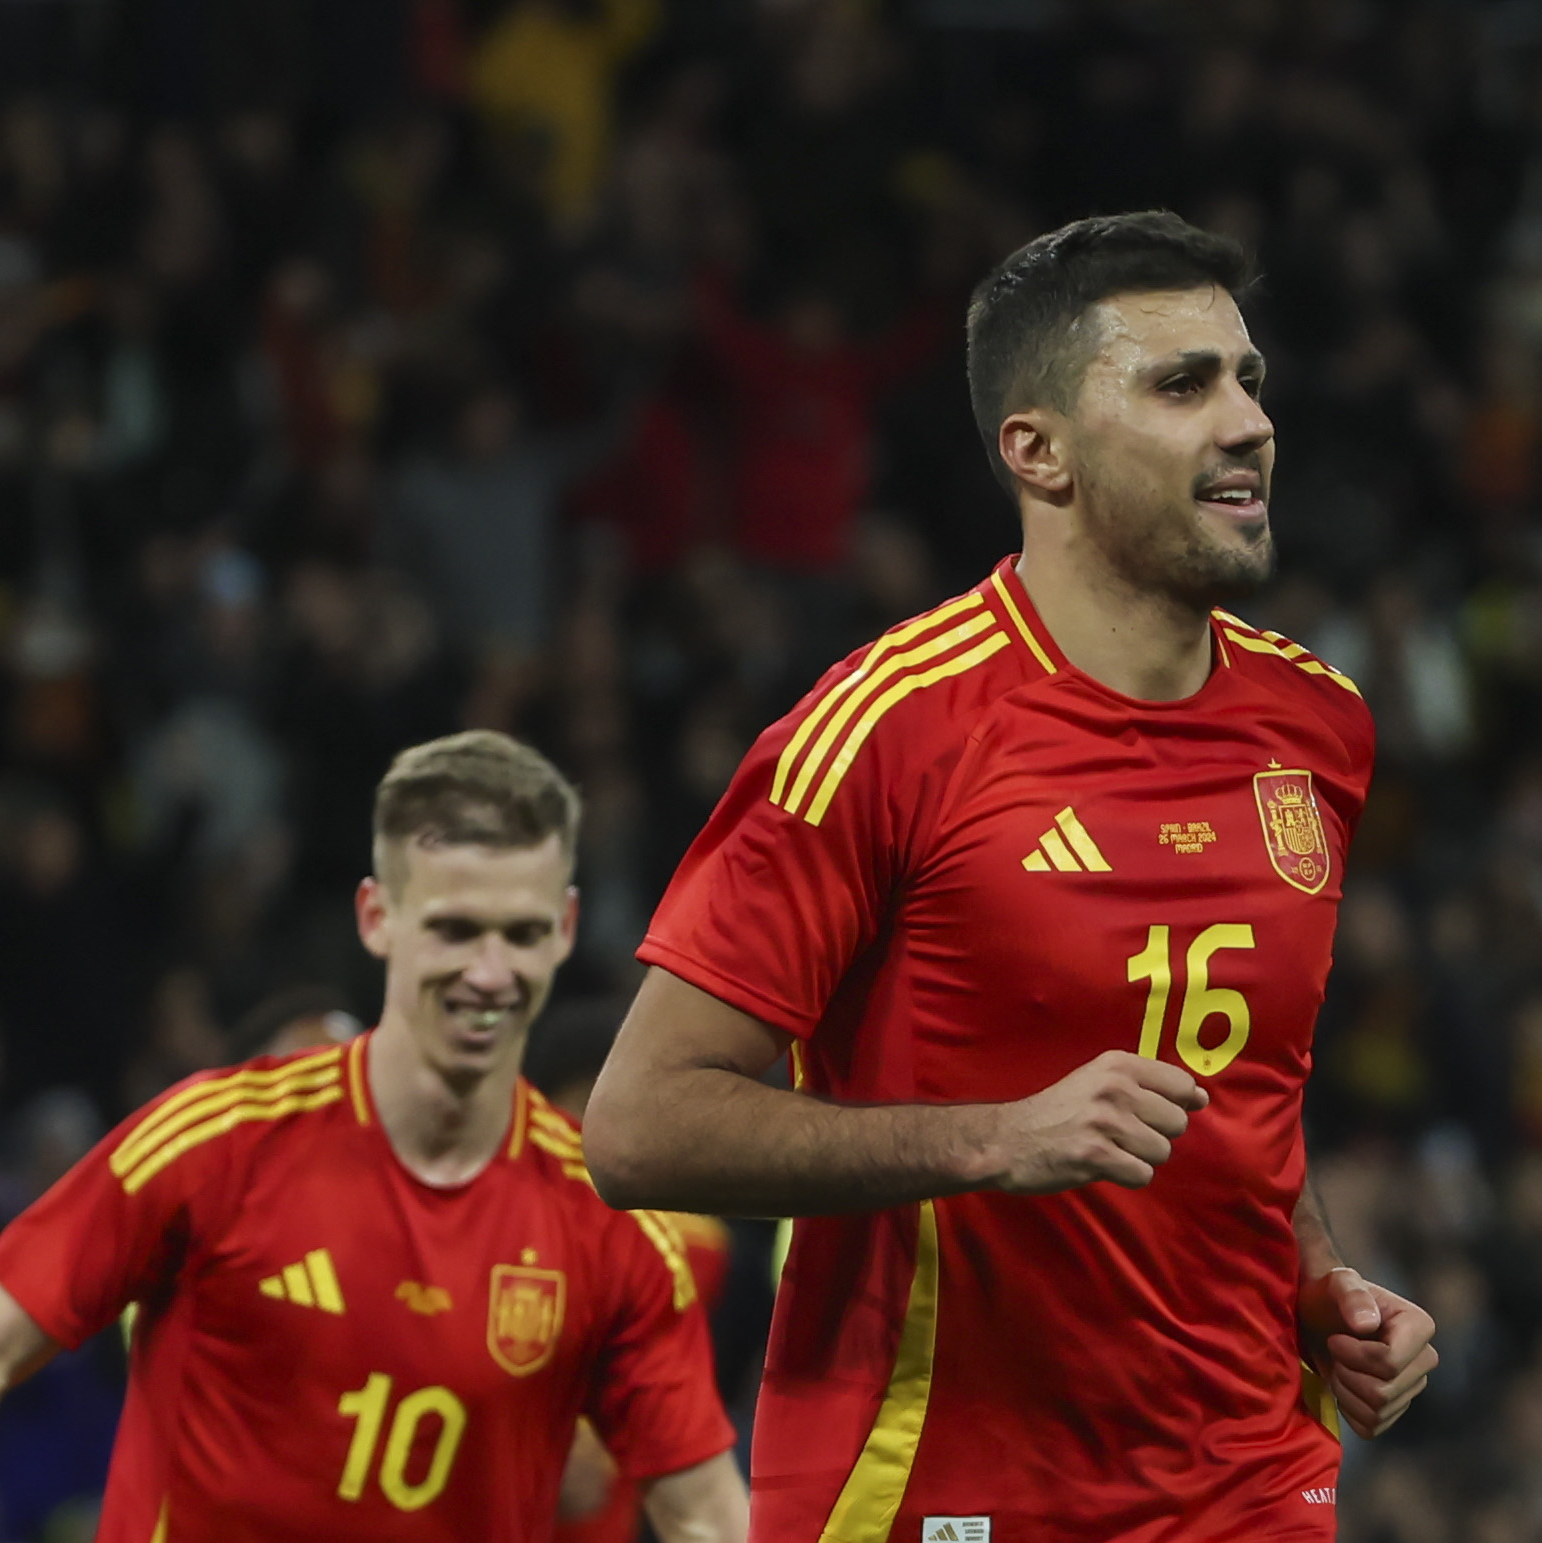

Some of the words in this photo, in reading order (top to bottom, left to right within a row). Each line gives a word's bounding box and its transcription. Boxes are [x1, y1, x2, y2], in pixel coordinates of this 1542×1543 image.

[1127, 923, 1255, 1077] 16
[338, 1371, 467, 1512] 10
[1301, 1487, 1336, 1505] HEAT
